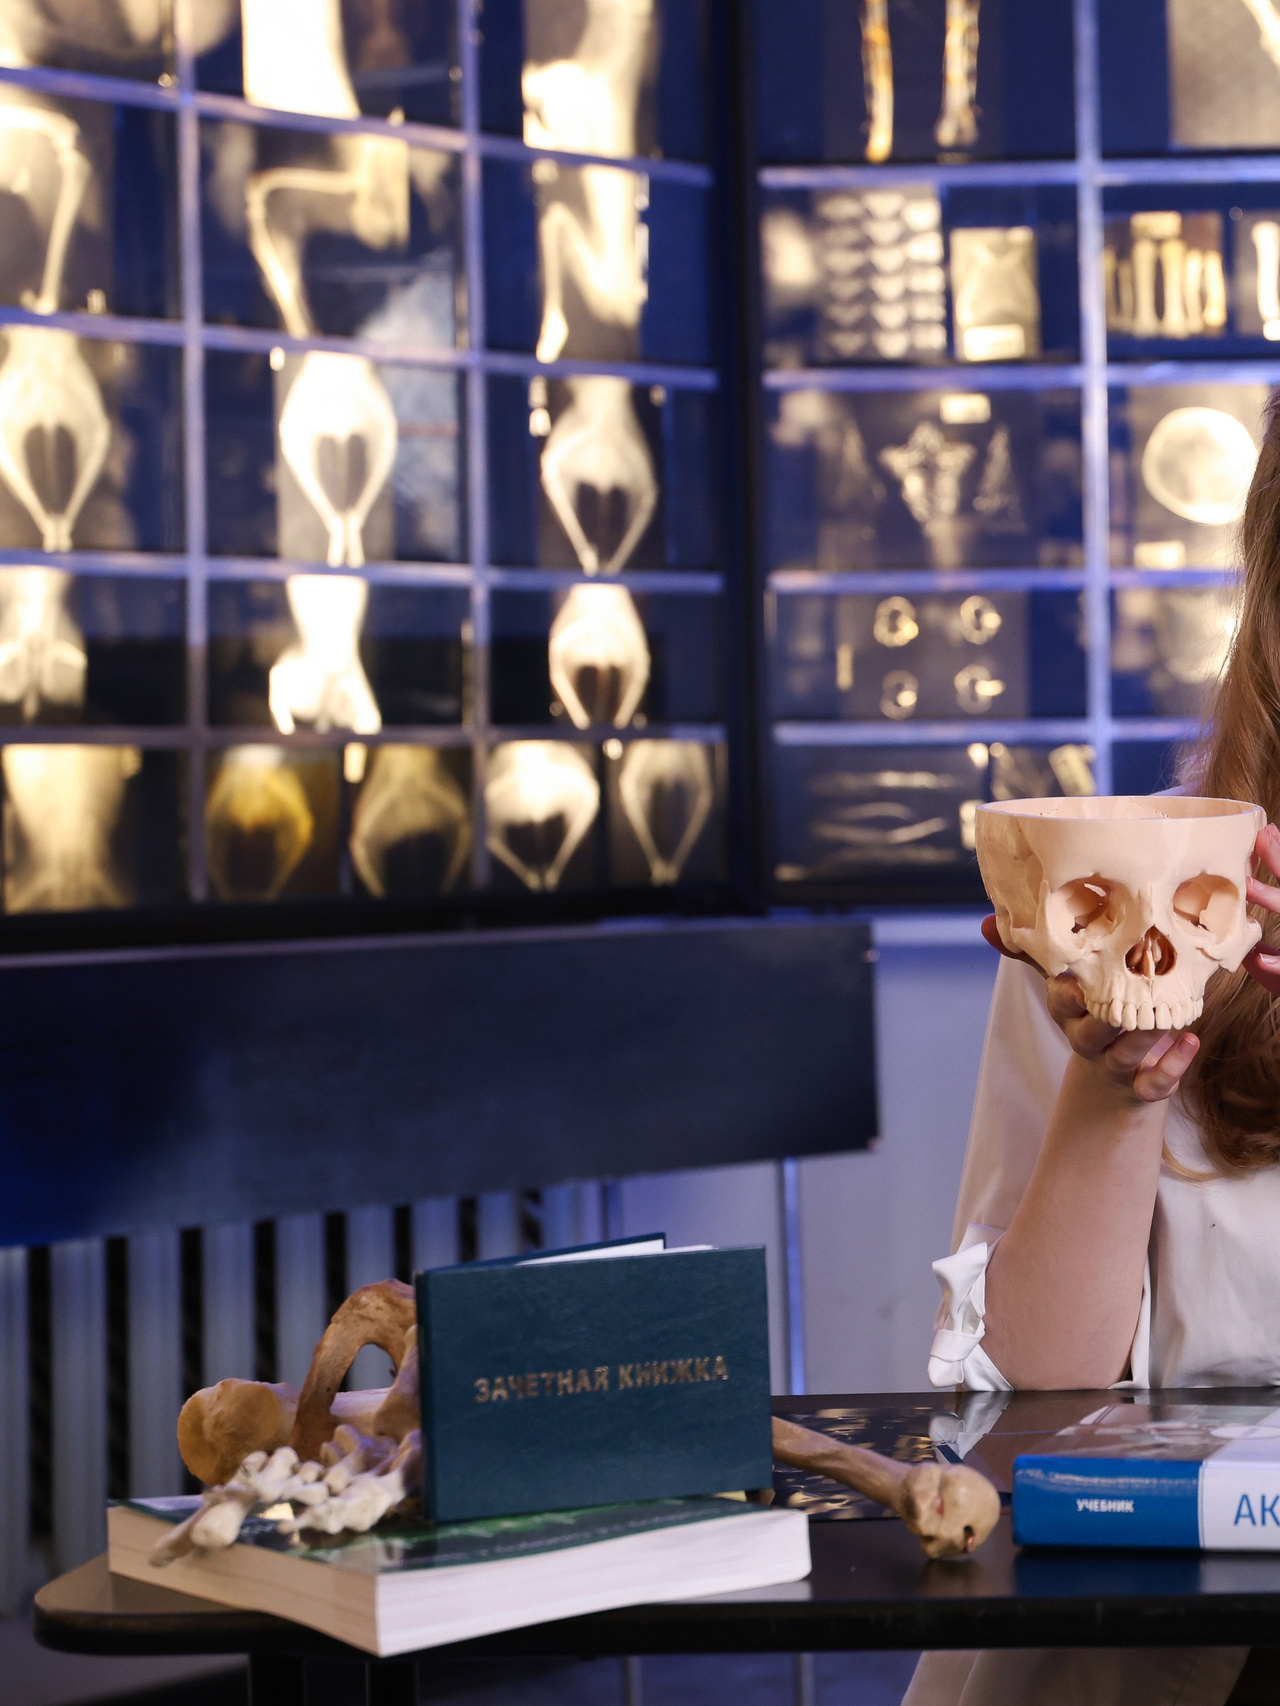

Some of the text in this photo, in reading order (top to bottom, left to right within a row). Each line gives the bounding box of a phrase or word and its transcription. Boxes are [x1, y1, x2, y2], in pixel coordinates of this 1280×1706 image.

[473, 1355, 729, 1402] ЗАЧЕТНАЯ КНИЖКА
[1076, 1498, 1135, 1513] УЧЕБНИК
